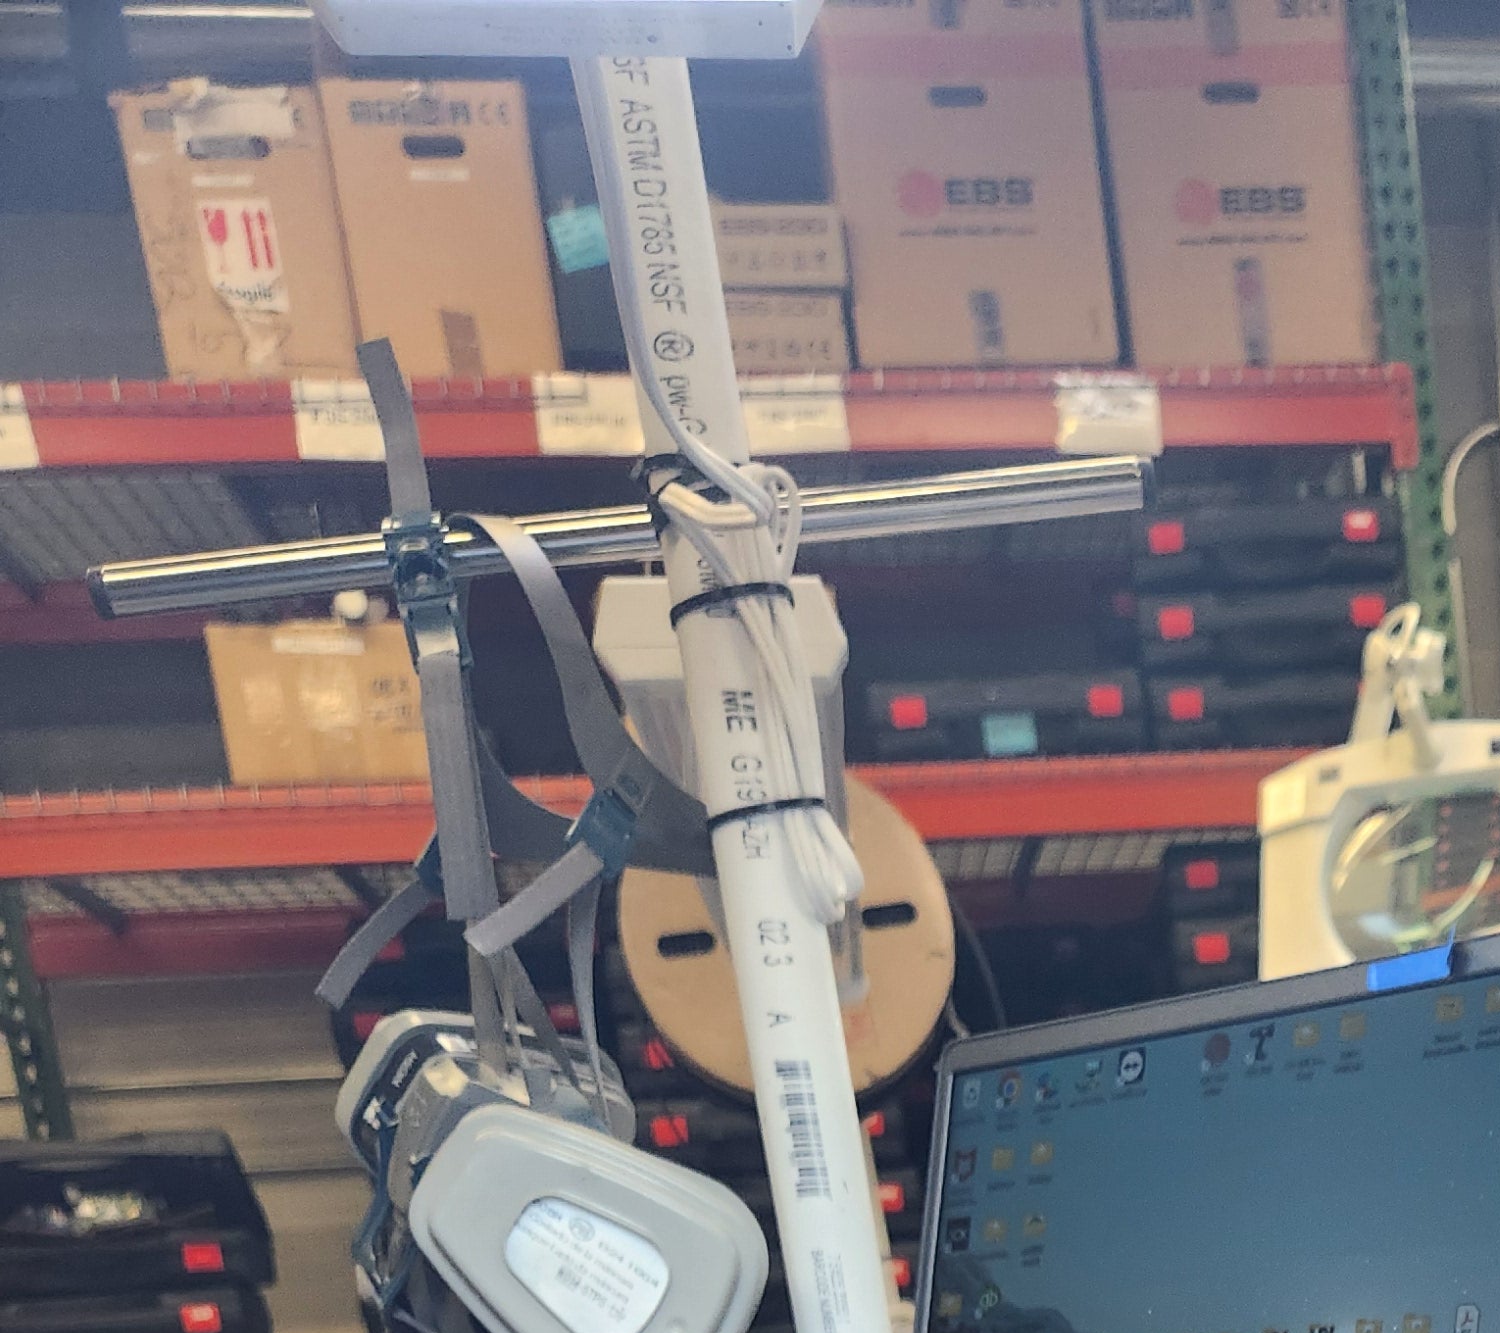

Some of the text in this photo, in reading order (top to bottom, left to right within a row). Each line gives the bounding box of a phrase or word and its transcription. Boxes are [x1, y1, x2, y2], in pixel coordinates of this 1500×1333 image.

[620, 99, 664, 171] ASTM
[633, 179, 677, 255] D1785
[943, 178, 1033, 205] EBS
[1218, 186, 1306, 213] EBS
[646, 262, 687, 315] NSF
